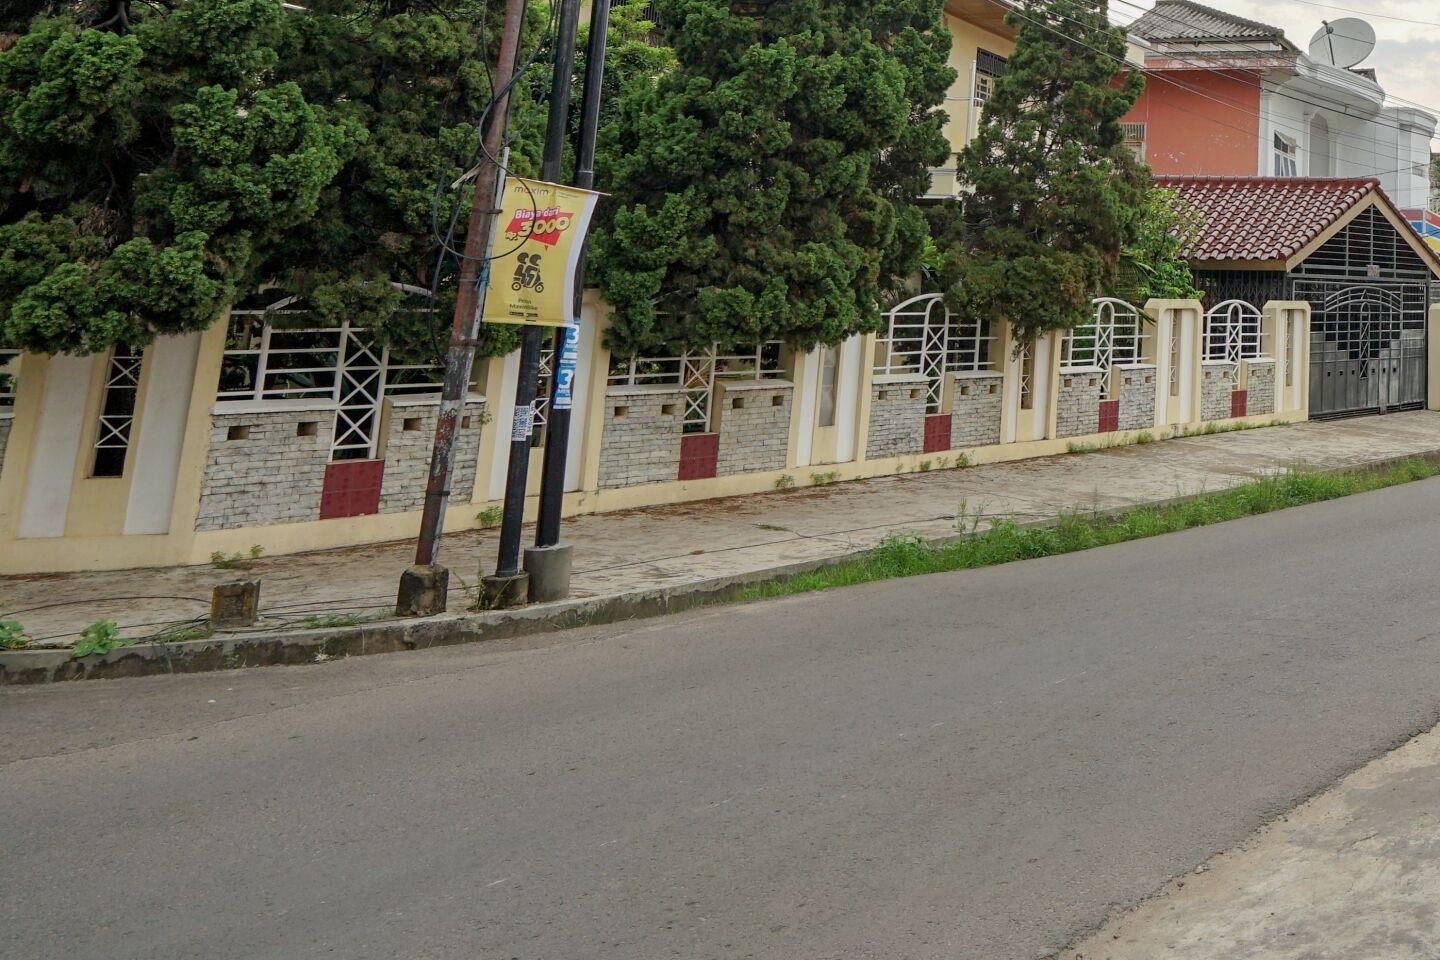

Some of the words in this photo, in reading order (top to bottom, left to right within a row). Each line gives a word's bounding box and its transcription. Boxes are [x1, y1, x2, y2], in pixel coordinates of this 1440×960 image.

[515, 208, 542, 220] Biaya
[543, 206, 560, 217] dari
[517, 217, 571, 237] 3000
